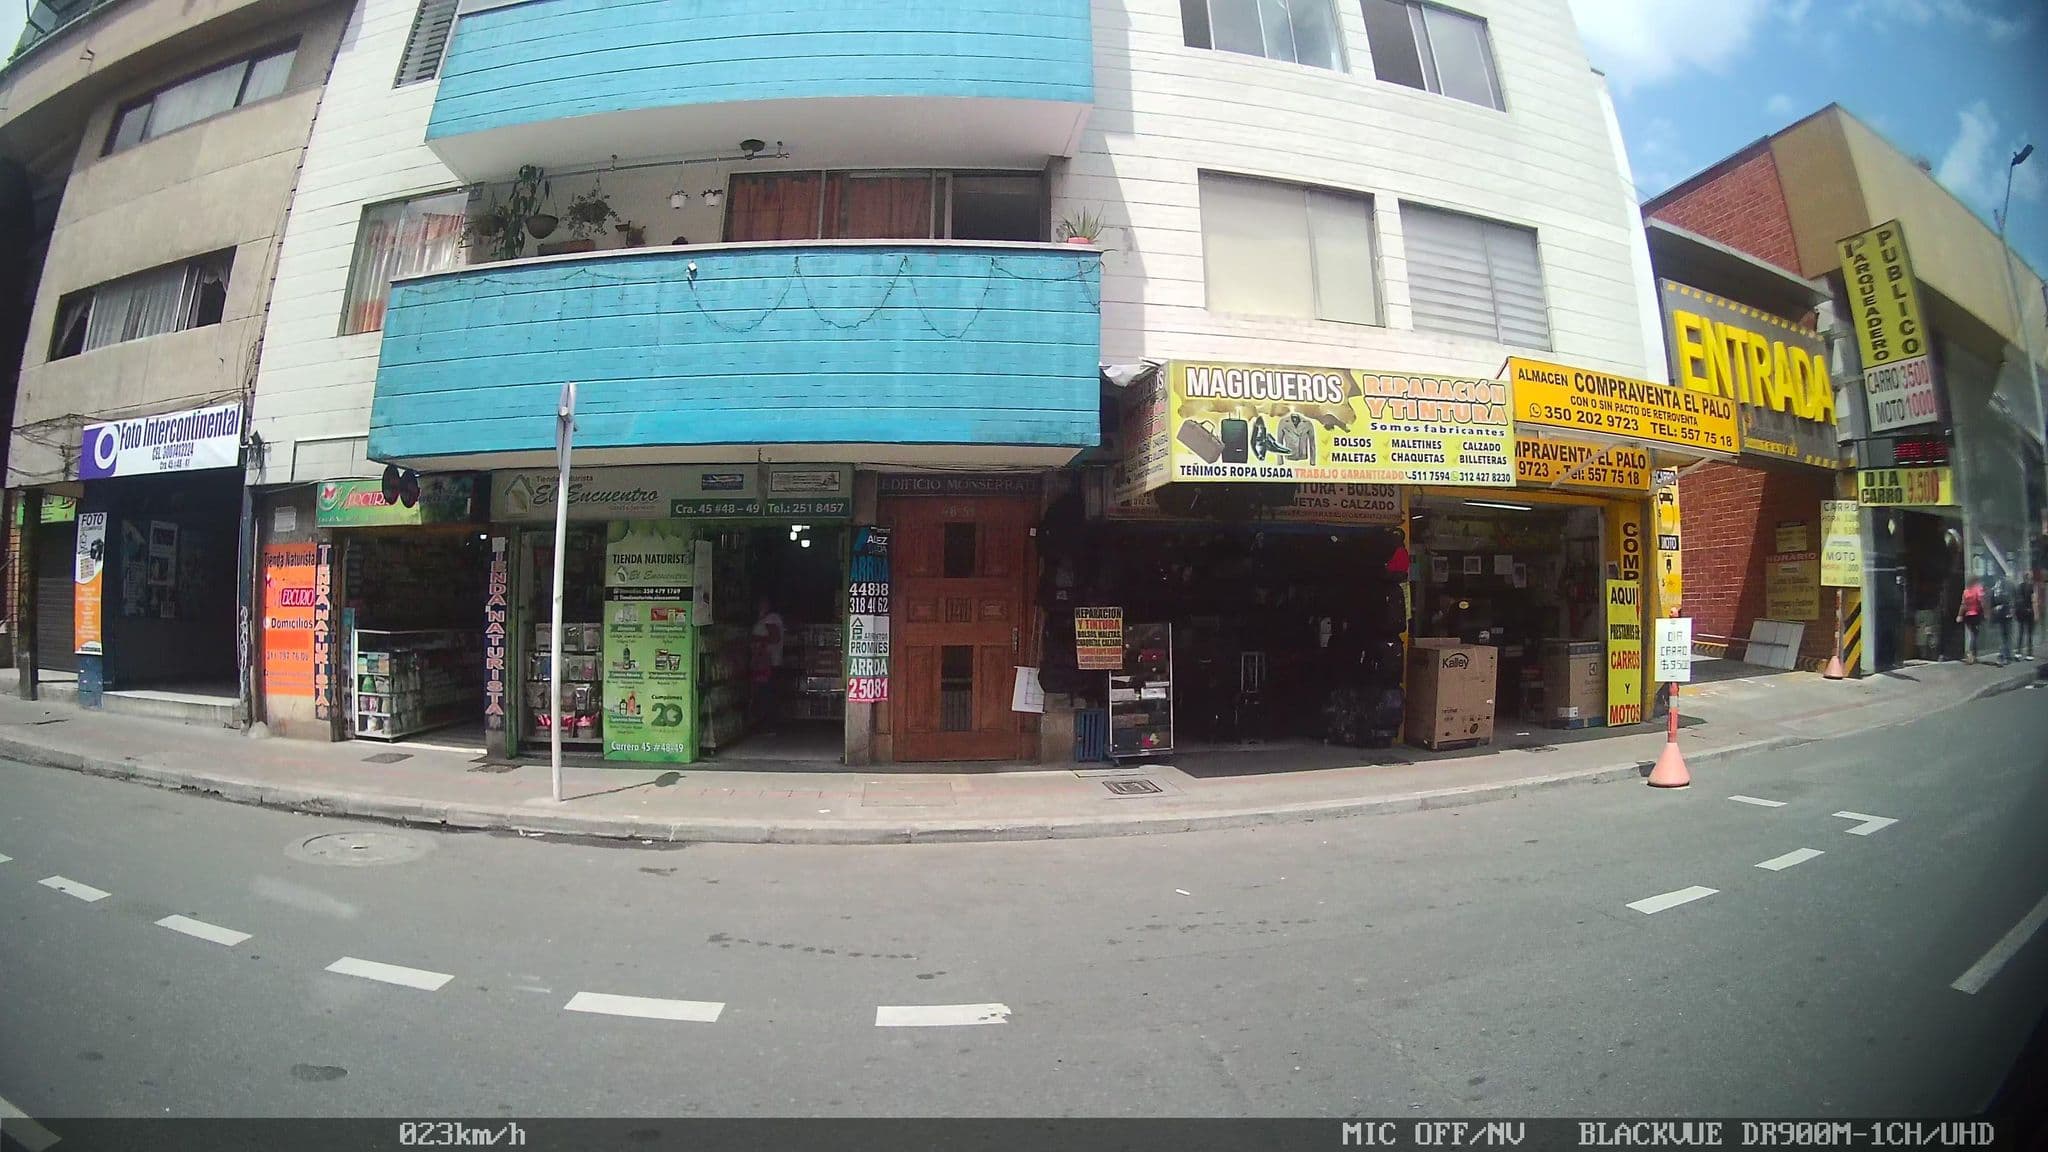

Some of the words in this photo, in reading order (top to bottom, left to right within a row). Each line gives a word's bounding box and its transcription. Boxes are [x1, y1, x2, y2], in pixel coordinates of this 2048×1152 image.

[1844, 236, 1889, 361] PARQUEADERO
[1876, 230, 1920, 355] PUBLICO
[1673, 310, 1837, 425] ENTRADA
[1185, 366, 1343, 404] MAGICUEROS
[1518, 368, 1568, 386] ALMACEN
[1866, 367, 1899, 394] CARRO
[1901, 361, 1929, 390] 3500
[1363, 374, 1506, 405] REPARACIÓN
[1574, 372, 1681, 410] COMPRAVENTA
[1683, 394, 1699, 413] EL
[1702, 398, 1730, 420] PALO
[1365, 397, 1387, 419] Y
[1388, 398, 1508, 426] TINTURA
[1570, 396, 1588, 407] CON
[1591, 399, 1597, 409] O
[1600, 400, 1612, 411] SIN
[1615, 403, 1639, 416] PACTO
[1641, 407, 1651, 417] DE
[1653, 409, 1698, 425] RETROVENTA
[1876, 398, 1904, 425] MOTO
[1905, 390, 1934, 419] 1000
[120, 423, 141, 450] Foto
[143, 401, 240, 446] Intercontinental
[1371, 423, 1419, 432] Somos
[1424, 424, 1505, 436] fabricantes
[1544, 406, 1571, 421] 350
[1576, 411, 1602, 426] 202
[1606, 415, 1639, 431] 9723
[1650, 422, 1677, 437] TEL:
[1681, 428, 1700, 440] 557
[1704, 432, 1716, 444] 75
[1720, 436, 1732, 447] 18
[1334, 438, 1371, 447] BOLSOS
[1392, 439, 1442, 449] MALETINES
[1463, 441, 1500, 451] CALZADO
[1332, 452, 1376, 463] MALETAS
[1391, 453, 1444, 463] CHAQUETAS
[1460, 455, 1507, 465] BILLETERAS
[1616, 452, 1645, 469] PALO
[1180, 463, 1227, 476] TEÑIMOS
[1230, 467, 1257, 478] ROPA
[1260, 467, 1293, 478] USADA
[1295, 468, 1338, 479] TRABAJO
[1341, 468, 1404, 480] GARANTIZADO
[1412, 472, 1427, 481] 511
[1430, 472, 1450, 481] 7594
[1459, 472, 1474, 481] 312
[1475, 473, 1490, 482] 427
[1492, 473, 1511, 482] 8230
[1519, 461, 1549, 477] 9723
[1588, 468, 1607, 482] 557
[1611, 470, 1624, 483] 75
[1628, 471, 1640, 484] 18
[1865, 471, 1899, 487] DIA
[880, 479, 941, 490] EDIFICIO
[1347, 484, 1395, 497] BOLSOS
[533, 484, 559, 505] El
[568, 484, 660, 505] Encuentro
[1862, 487, 1902, 503] CARRO
[675, 504, 696, 513] Cra.
[699, 504, 711, 513] 45
[714, 504, 735, 513] #48
[746, 504, 759, 513] 49
[768, 504, 790, 513] Tel.:
[793, 504, 813, 513] 251
[815, 504, 844, 513] 8457
[1341, 499, 1395, 510] CALZADO
[81, 513, 104, 526] FOTO
[1661, 537, 1677, 549] MOTO
[613, 554, 641, 564] TIENDA
[645, 553, 687, 564] NATURIST
[1826, 552, 1856, 561] MOTO
[849, 597, 866, 613] 318
[1611, 587, 1637, 605] AQUI
[271, 617, 313, 629] Domicilios
[314, 609, 330, 705] NATURISTA
[485, 610, 505, 714] NATURISTA
[1442, 656, 1468, 669] Kalley
[1611, 651, 1640, 670] CARROS
[1625, 683, 1630, 694] Y
[651, 702, 683, 727] 20
[1610, 705, 1640, 724] MOTOS
